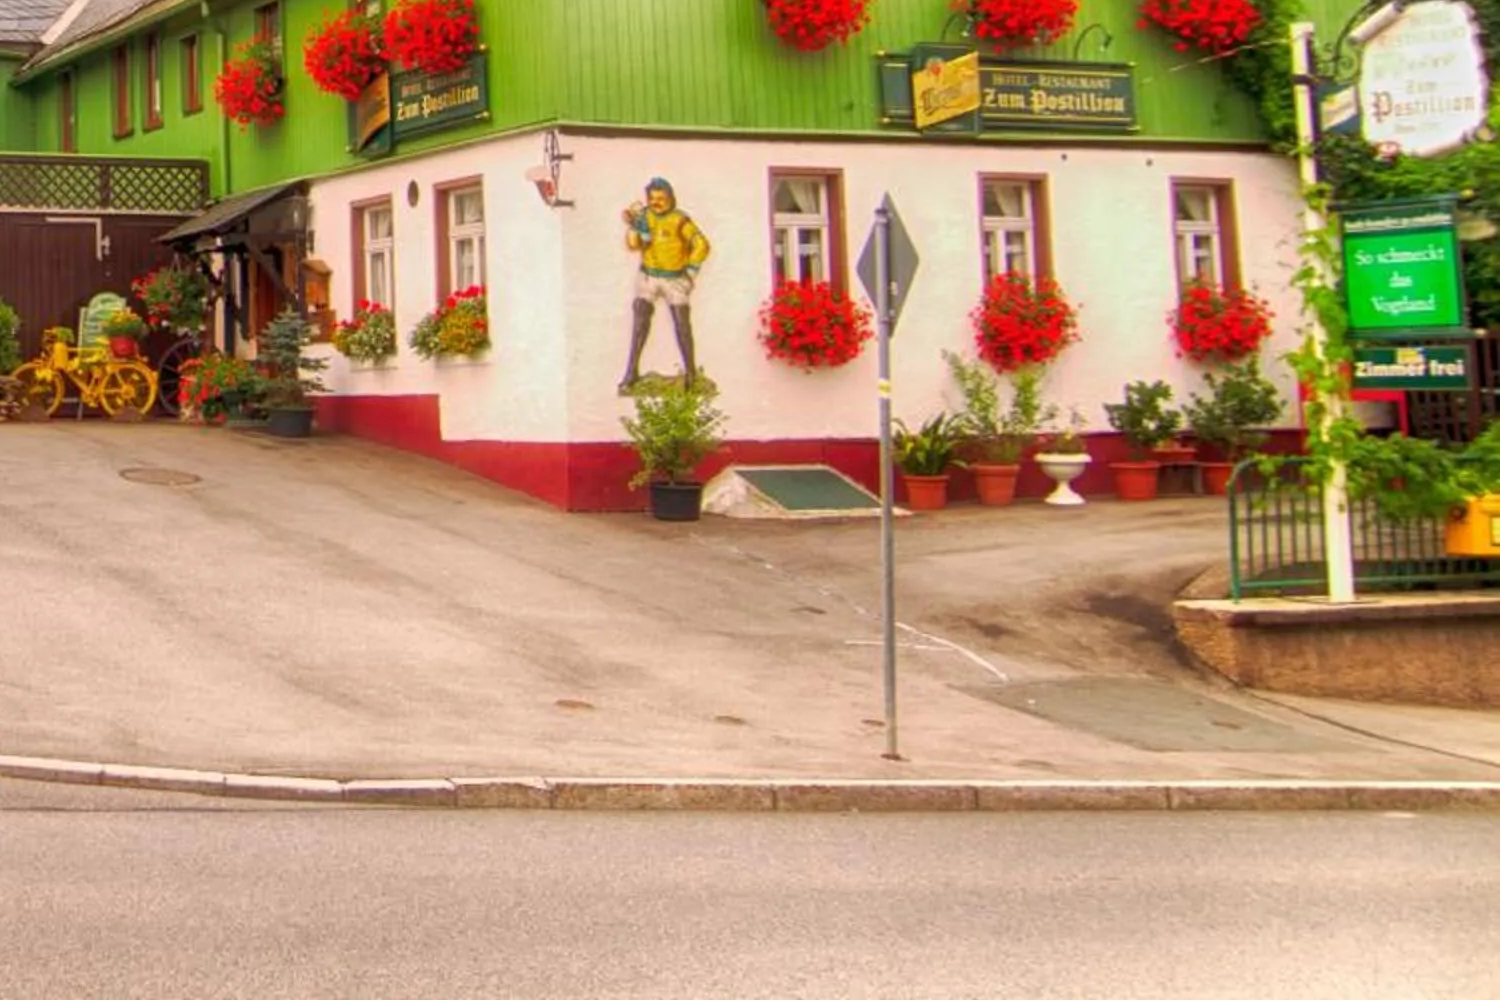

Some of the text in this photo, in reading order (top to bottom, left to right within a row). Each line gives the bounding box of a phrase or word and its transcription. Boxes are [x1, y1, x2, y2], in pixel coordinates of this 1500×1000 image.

[422, 85, 479, 118] Postillion
[984, 88, 1025, 108] Zum
[1030, 88, 1124, 114] Postillion
[1371, 89, 1476, 123] Postillion
[1354, 250, 1375, 265] So
[1355, 359, 1465, 377] Zimmer frei
